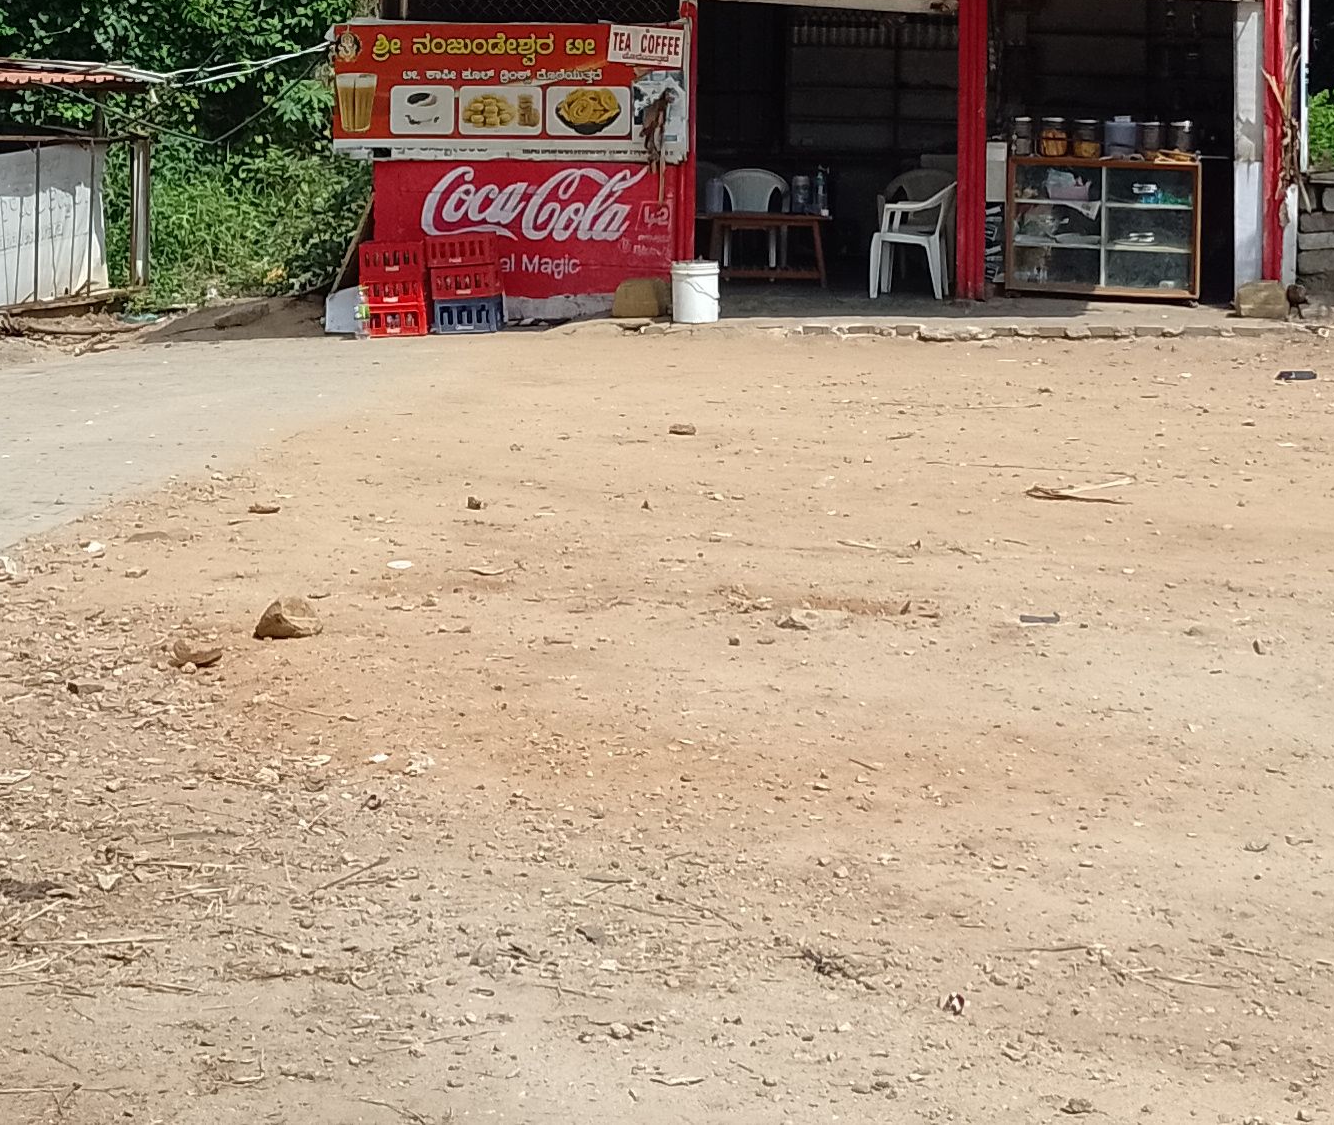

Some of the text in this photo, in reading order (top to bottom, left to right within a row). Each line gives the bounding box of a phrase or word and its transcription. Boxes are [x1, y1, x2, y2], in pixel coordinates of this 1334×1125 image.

[371, 32, 596, 66] ಶ್ರೀ ನಂಜುಂಡೇಶ್ವರ ಟೀ
[613, 32, 681, 56] TEA COFFEE
[421, 165, 649, 242] Coca-Cola
[521, 253, 582, 280] Magic
